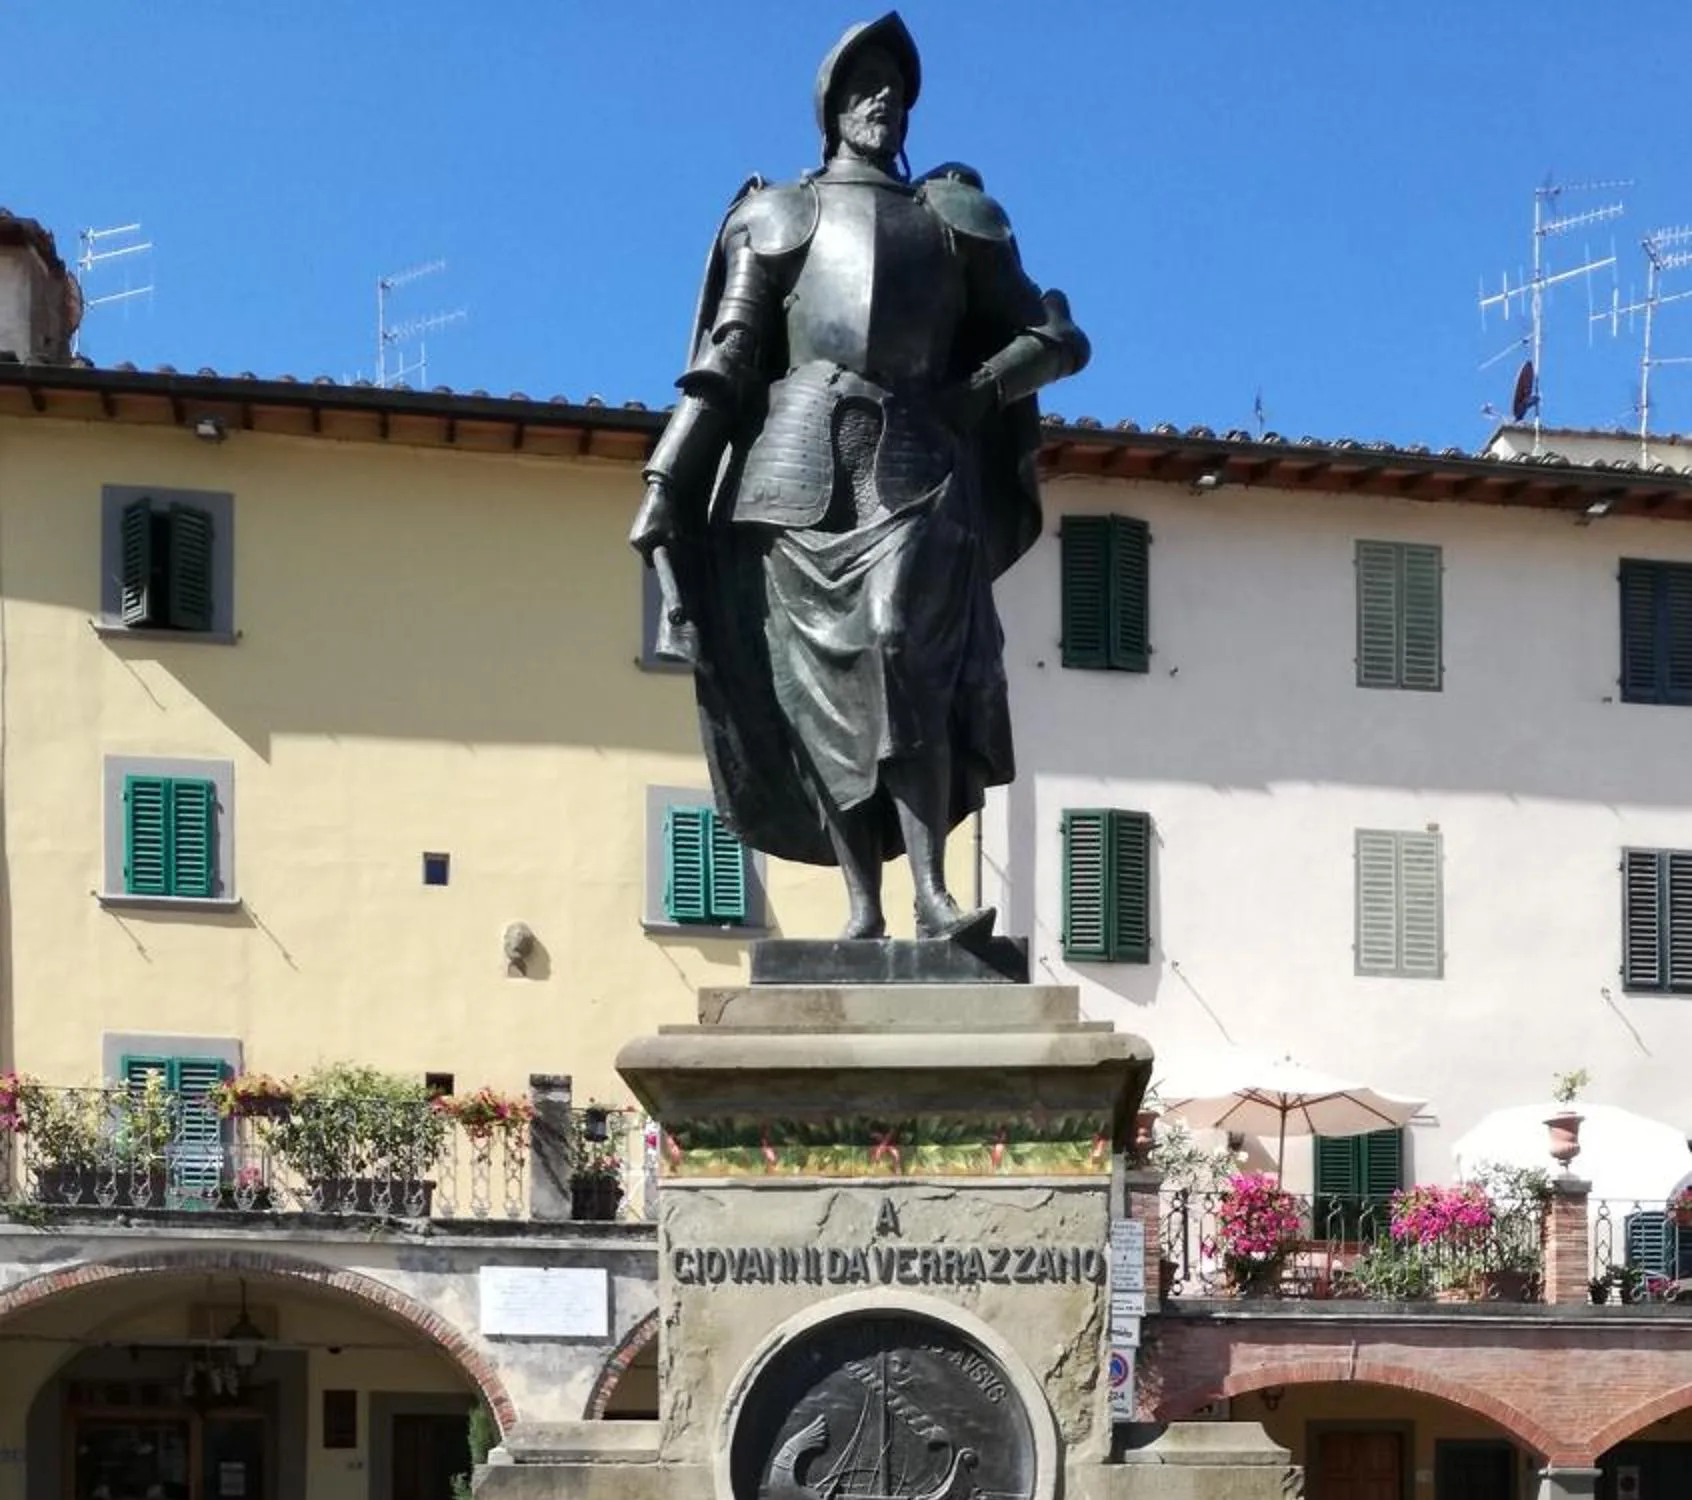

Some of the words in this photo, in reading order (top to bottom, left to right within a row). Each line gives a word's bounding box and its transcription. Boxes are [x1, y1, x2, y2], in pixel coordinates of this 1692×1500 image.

[875, 1197, 900, 1237] A
[674, 1247, 822, 1285] GIOVANNI
[826, 1247, 870, 1284] DA
[872, 1247, 1107, 1285] VERRAZZANO
